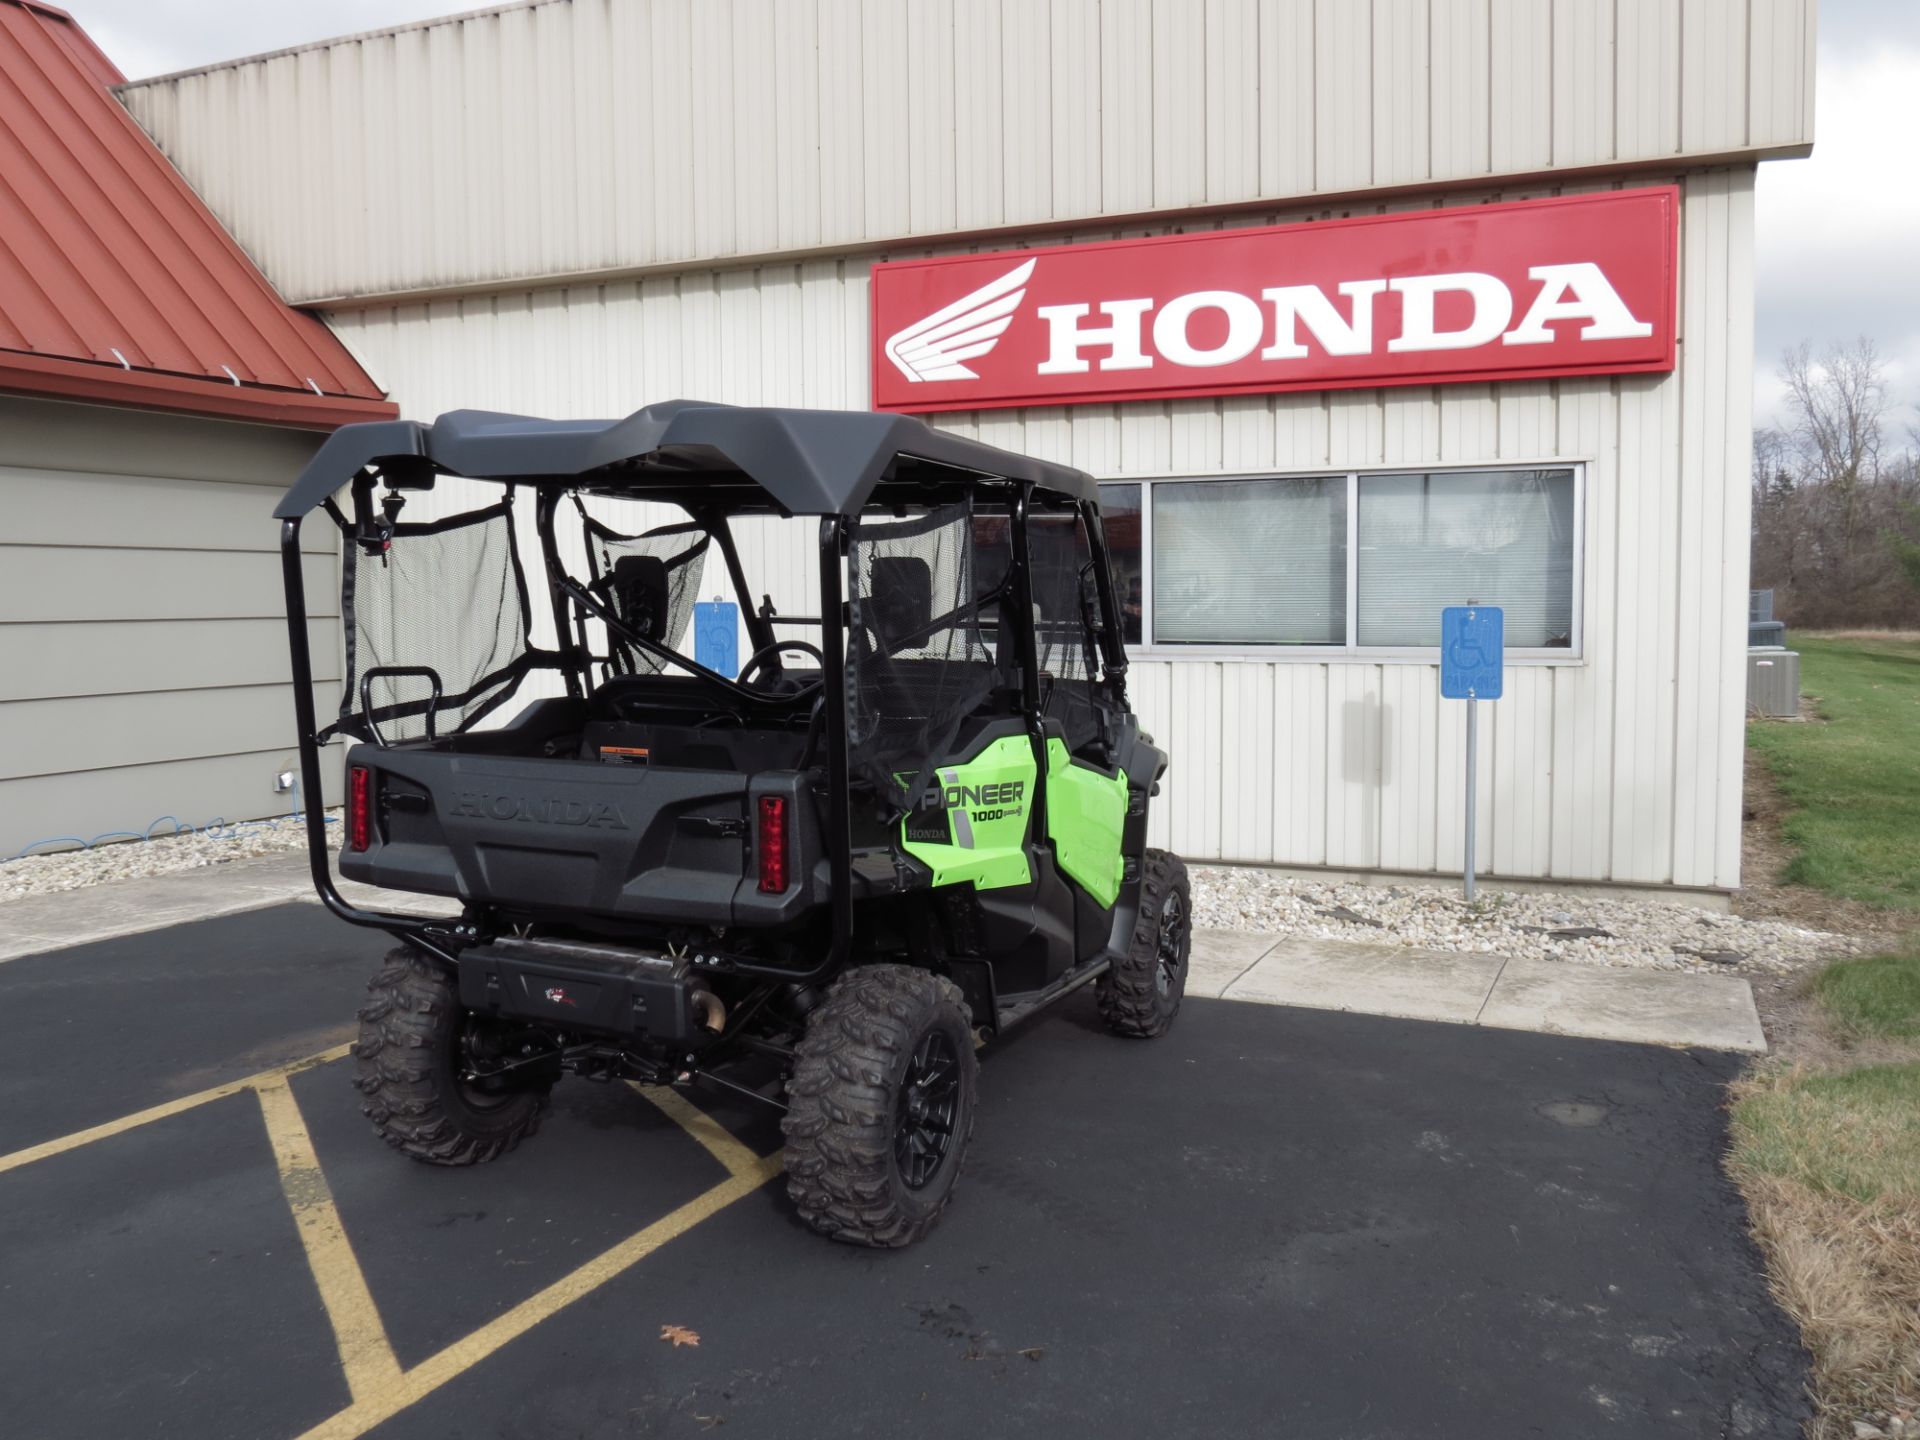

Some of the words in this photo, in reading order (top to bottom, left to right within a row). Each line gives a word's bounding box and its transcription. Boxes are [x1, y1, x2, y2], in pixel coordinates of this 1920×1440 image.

[1036, 261, 1654, 376] HONDA
[450, 791, 631, 830] HONDA
[921, 781, 1024, 811] PIONEER
[971, 809, 1004, 822] 1000
[908, 829, 946, 840] HONDA
